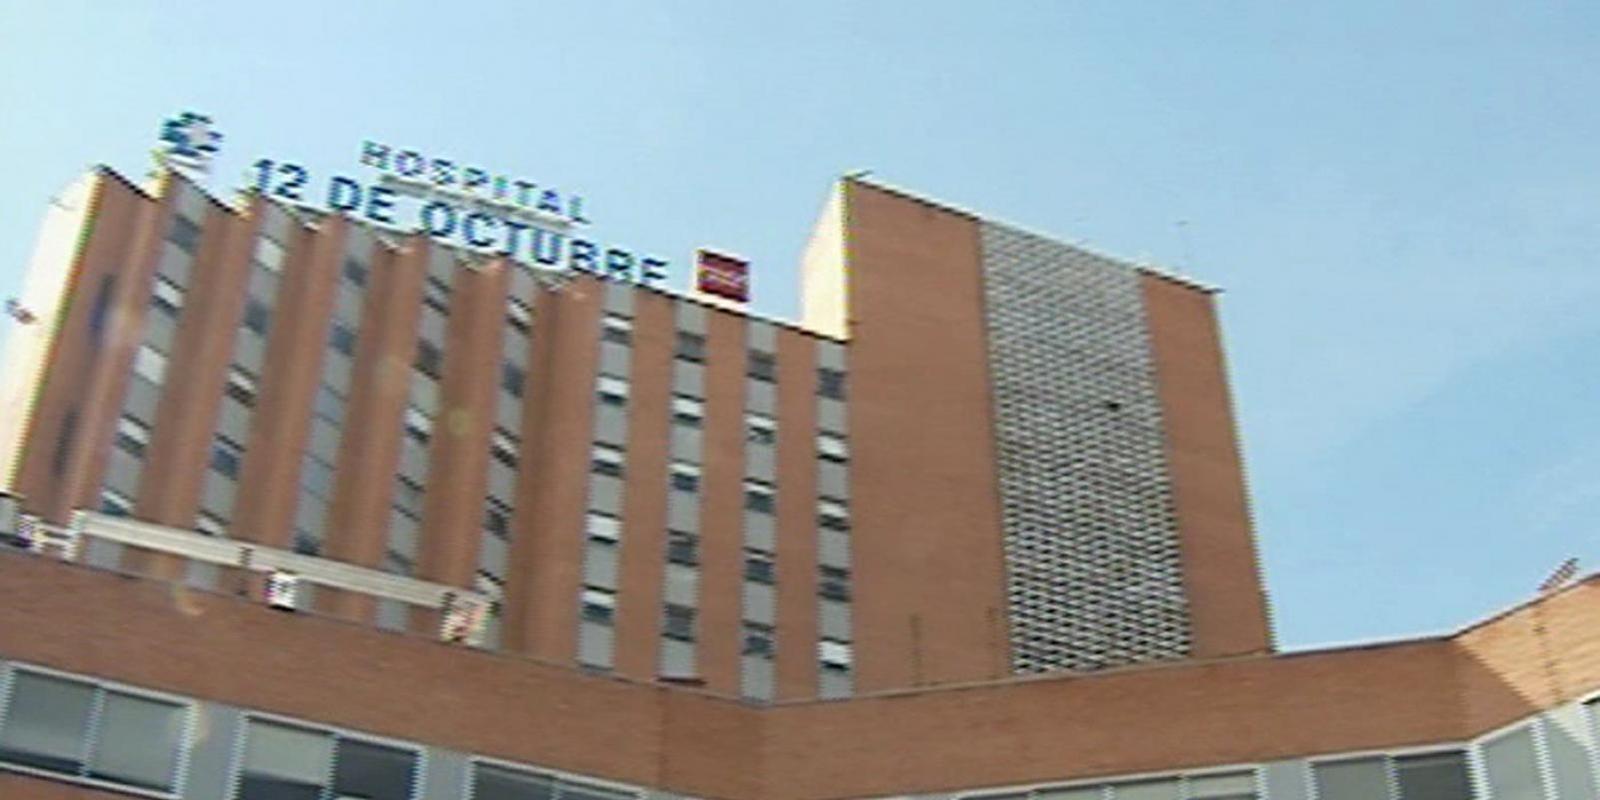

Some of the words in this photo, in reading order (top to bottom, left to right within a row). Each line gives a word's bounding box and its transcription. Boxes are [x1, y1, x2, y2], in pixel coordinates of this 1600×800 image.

[252, 158, 307, 199] 12
[328, 175, 395, 223] DE
[420, 201, 669, 283] OCTUBRE
[361, 140, 591, 224] HOSPITAL
